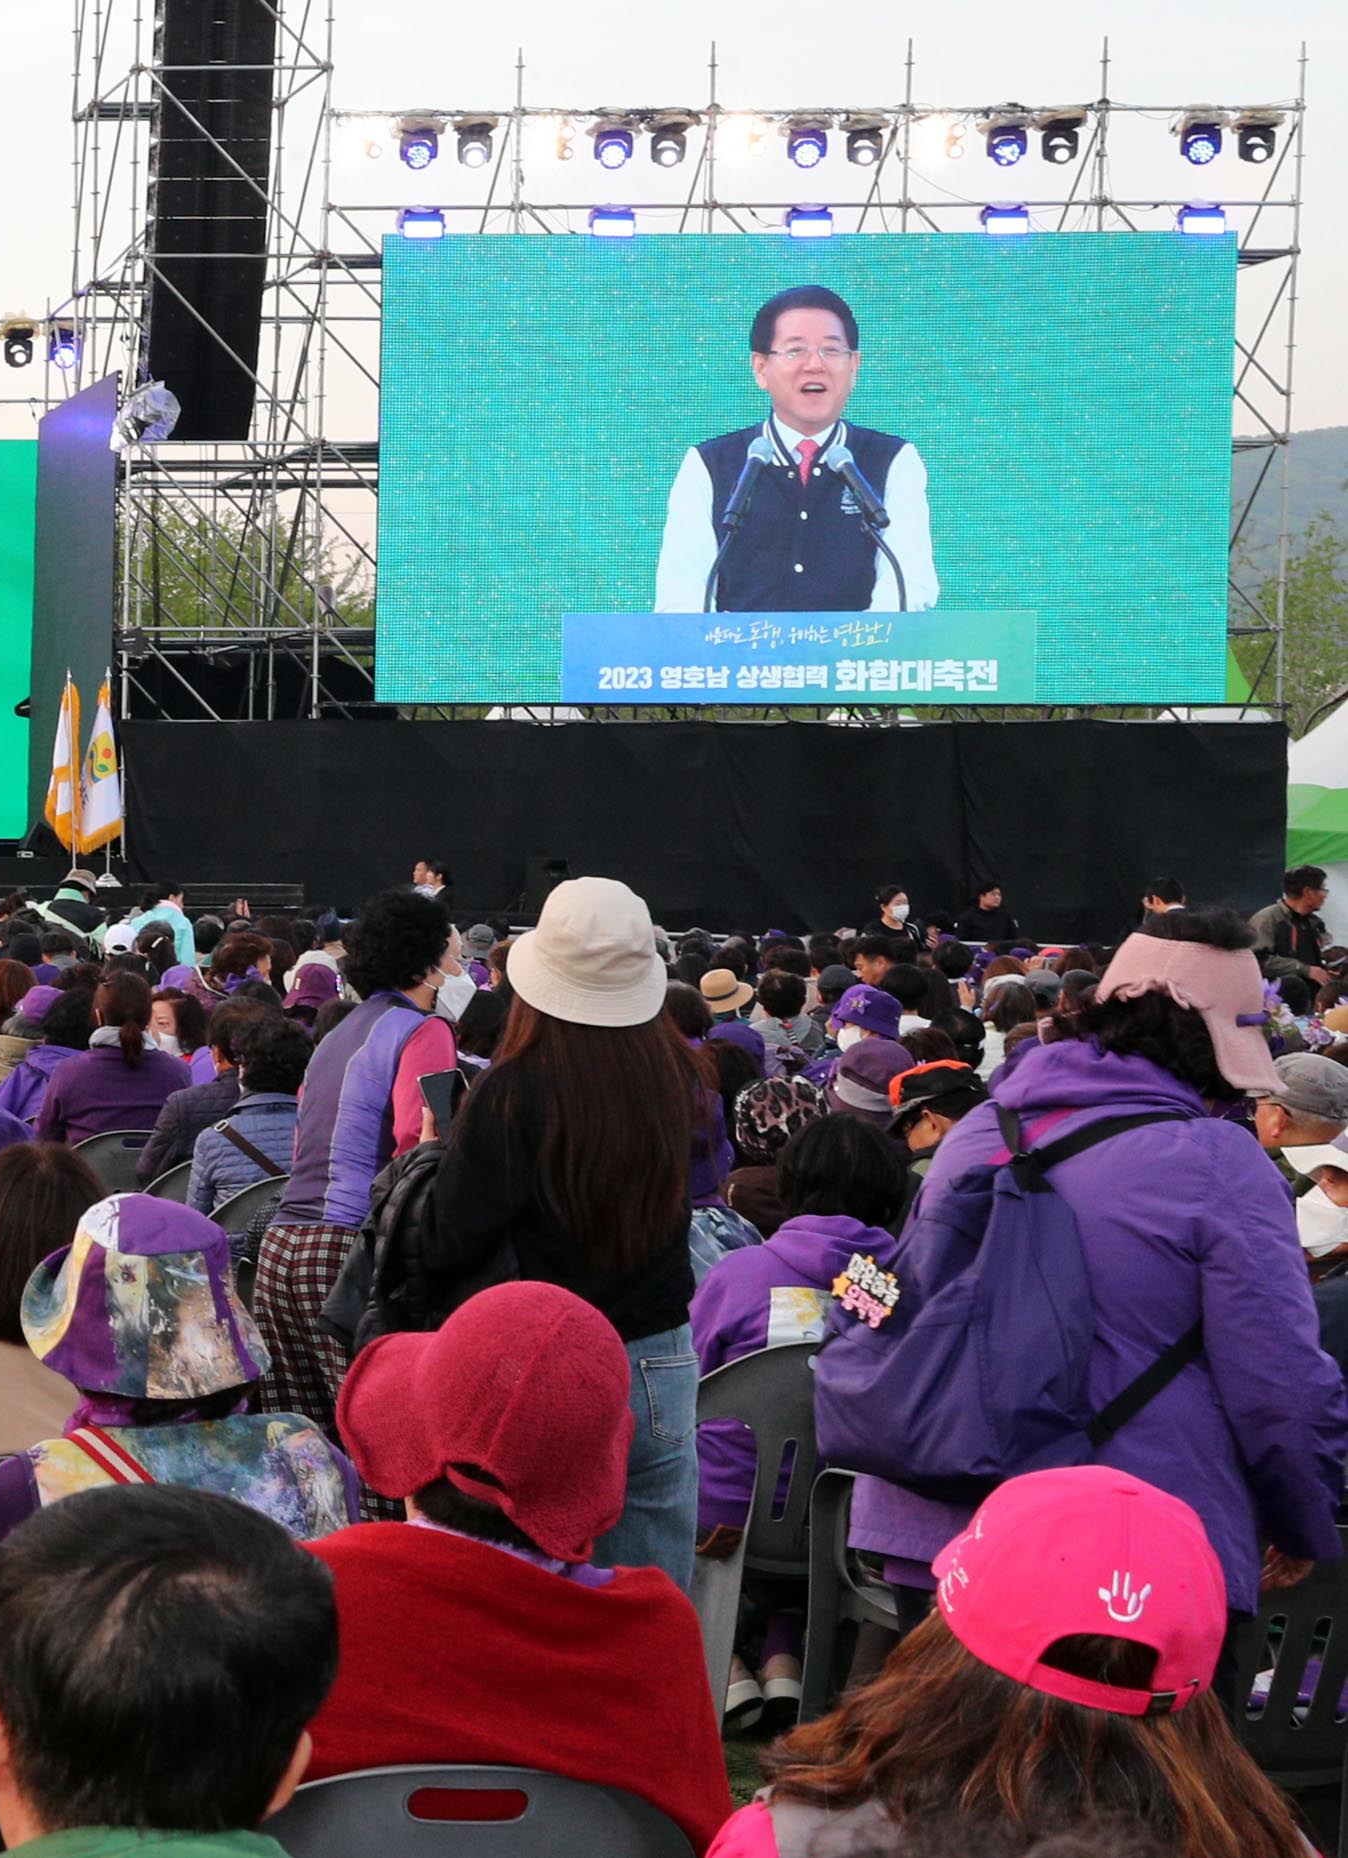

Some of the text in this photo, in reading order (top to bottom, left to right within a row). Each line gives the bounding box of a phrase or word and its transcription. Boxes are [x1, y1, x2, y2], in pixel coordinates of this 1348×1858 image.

[833, 620, 892, 647] 영호남!
[598, 659, 998, 692] 2023 영호남 상생협력 화합대축전
